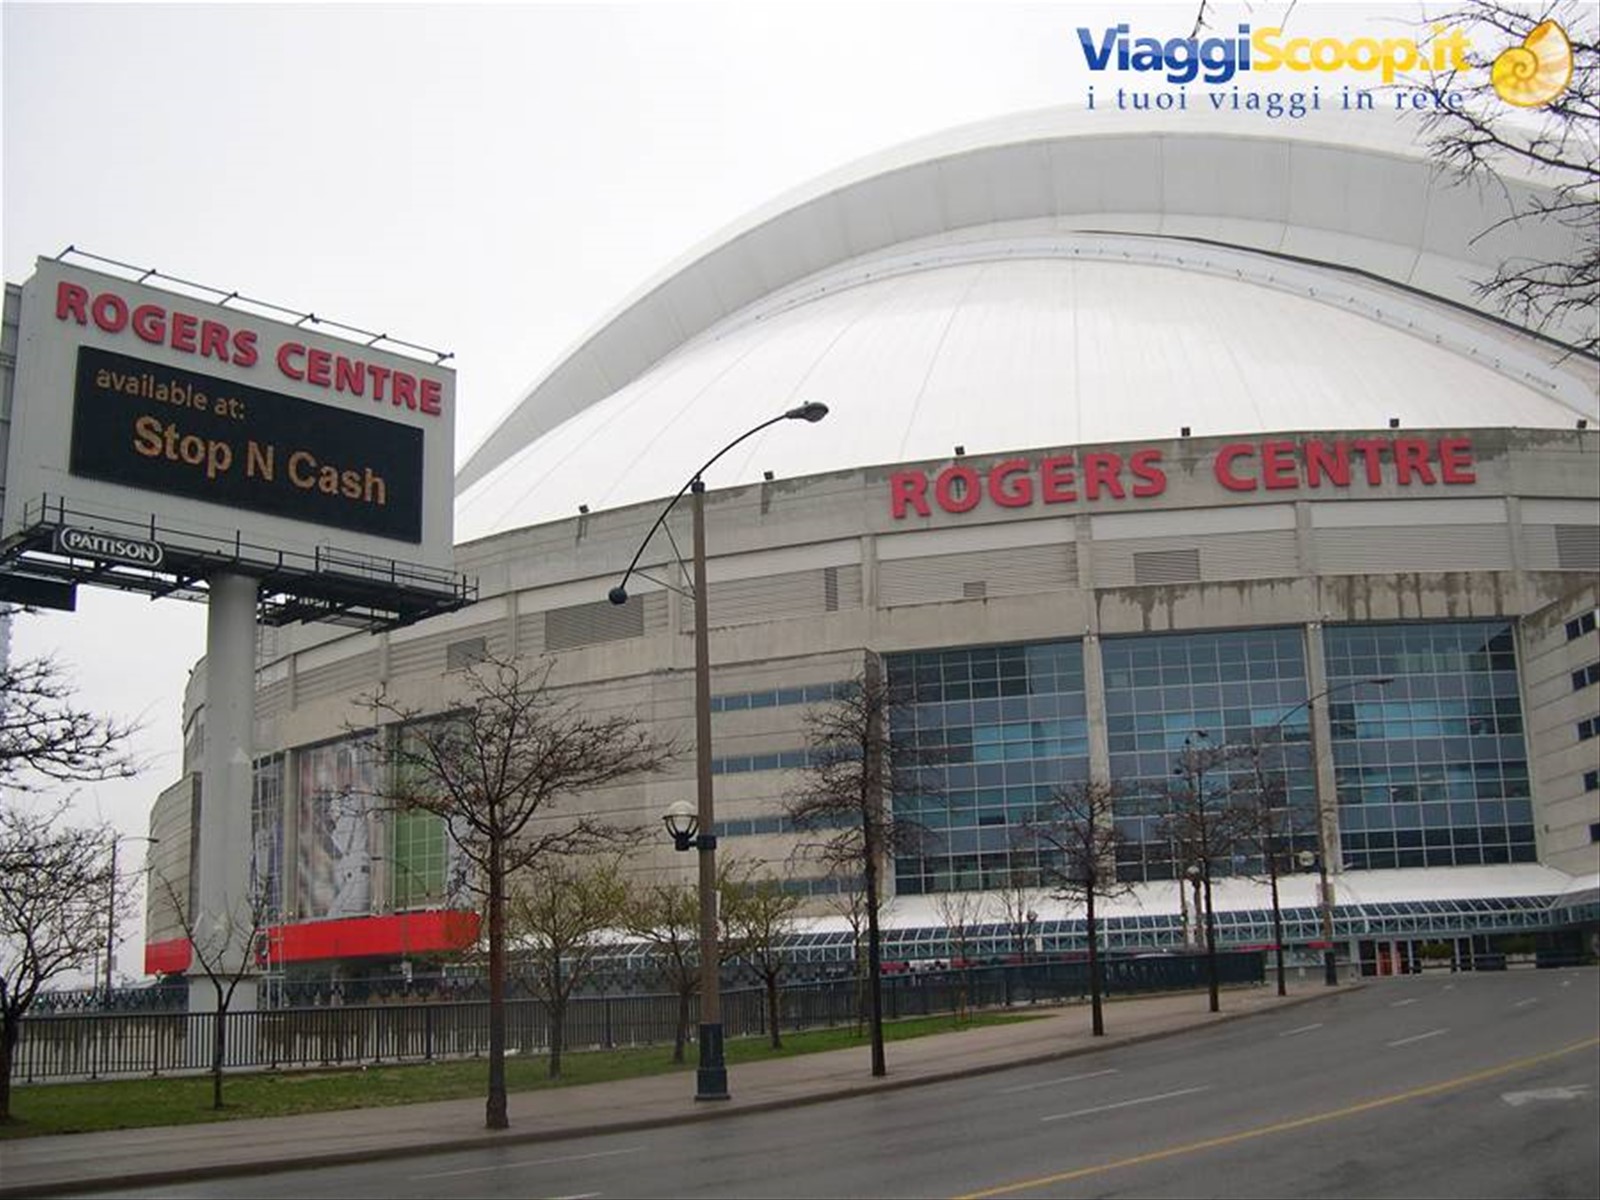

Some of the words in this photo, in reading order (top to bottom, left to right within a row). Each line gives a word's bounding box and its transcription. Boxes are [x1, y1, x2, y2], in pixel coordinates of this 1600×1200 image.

[57, 282, 258, 366] ROGERS
[277, 342, 442, 415] CENTRE
[96, 368, 207, 414] available
[214, 397, 245, 420] at:
[133, 415, 232, 479] Stop
[247, 441, 274, 481] N
[287, 451, 387, 505] Cash
[890, 450, 1168, 519] ROGERS
[1215, 437, 1477, 493] CENTRE
[69, 533, 156, 560] PATTISON
